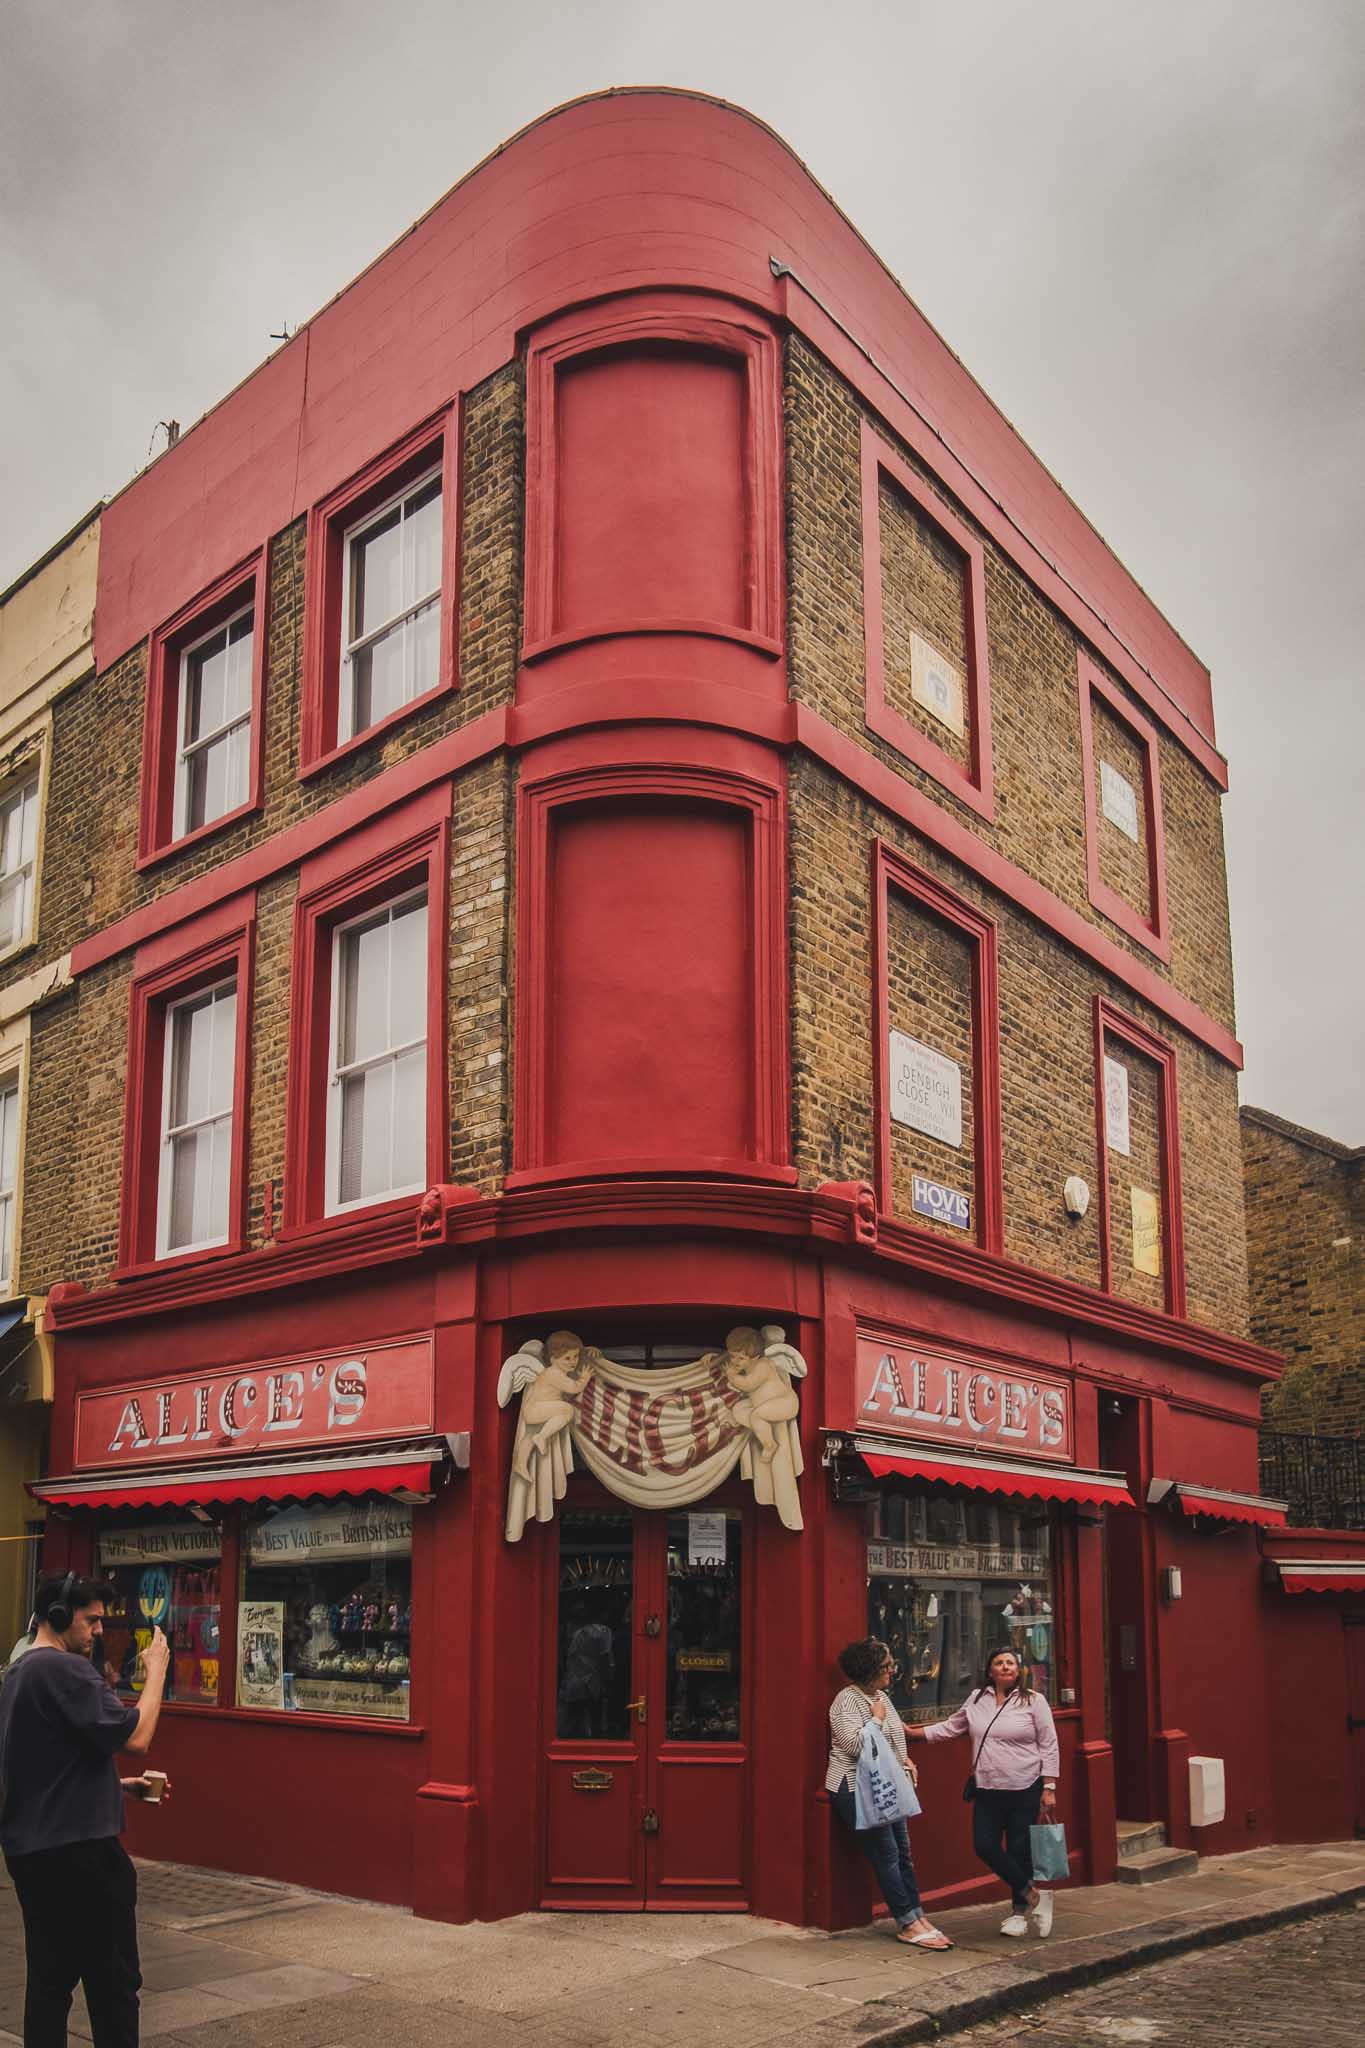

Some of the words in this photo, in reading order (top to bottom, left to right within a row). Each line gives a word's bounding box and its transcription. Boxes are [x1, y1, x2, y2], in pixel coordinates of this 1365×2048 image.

[897, 1079, 929, 1105] CLOSE
[902, 1063, 950, 1100] DENBIGH
[914, 1179, 968, 1218] HOVIS
[108, 1355, 367, 1452] ALICE'S
[863, 1353, 1064, 1446] ALICE'S
[136, 1532, 168, 1558] QUEEN
[170, 1529, 220, 1552] VICTORIA
[264, 1530, 288, 1551] BEST
[289, 1527, 323, 1549] VALUE
[341, 1523, 383, 1544] BRITISH
[384, 1519, 412, 1540] ISLES
[869, 1551, 884, 1565] THE
[885, 1548, 914, 1569] BEST
[918, 1550, 950, 1570] VALUE
[976, 1550, 1013, 1573] BRITISH
[680, 1656, 725, 1666] CLOSED
